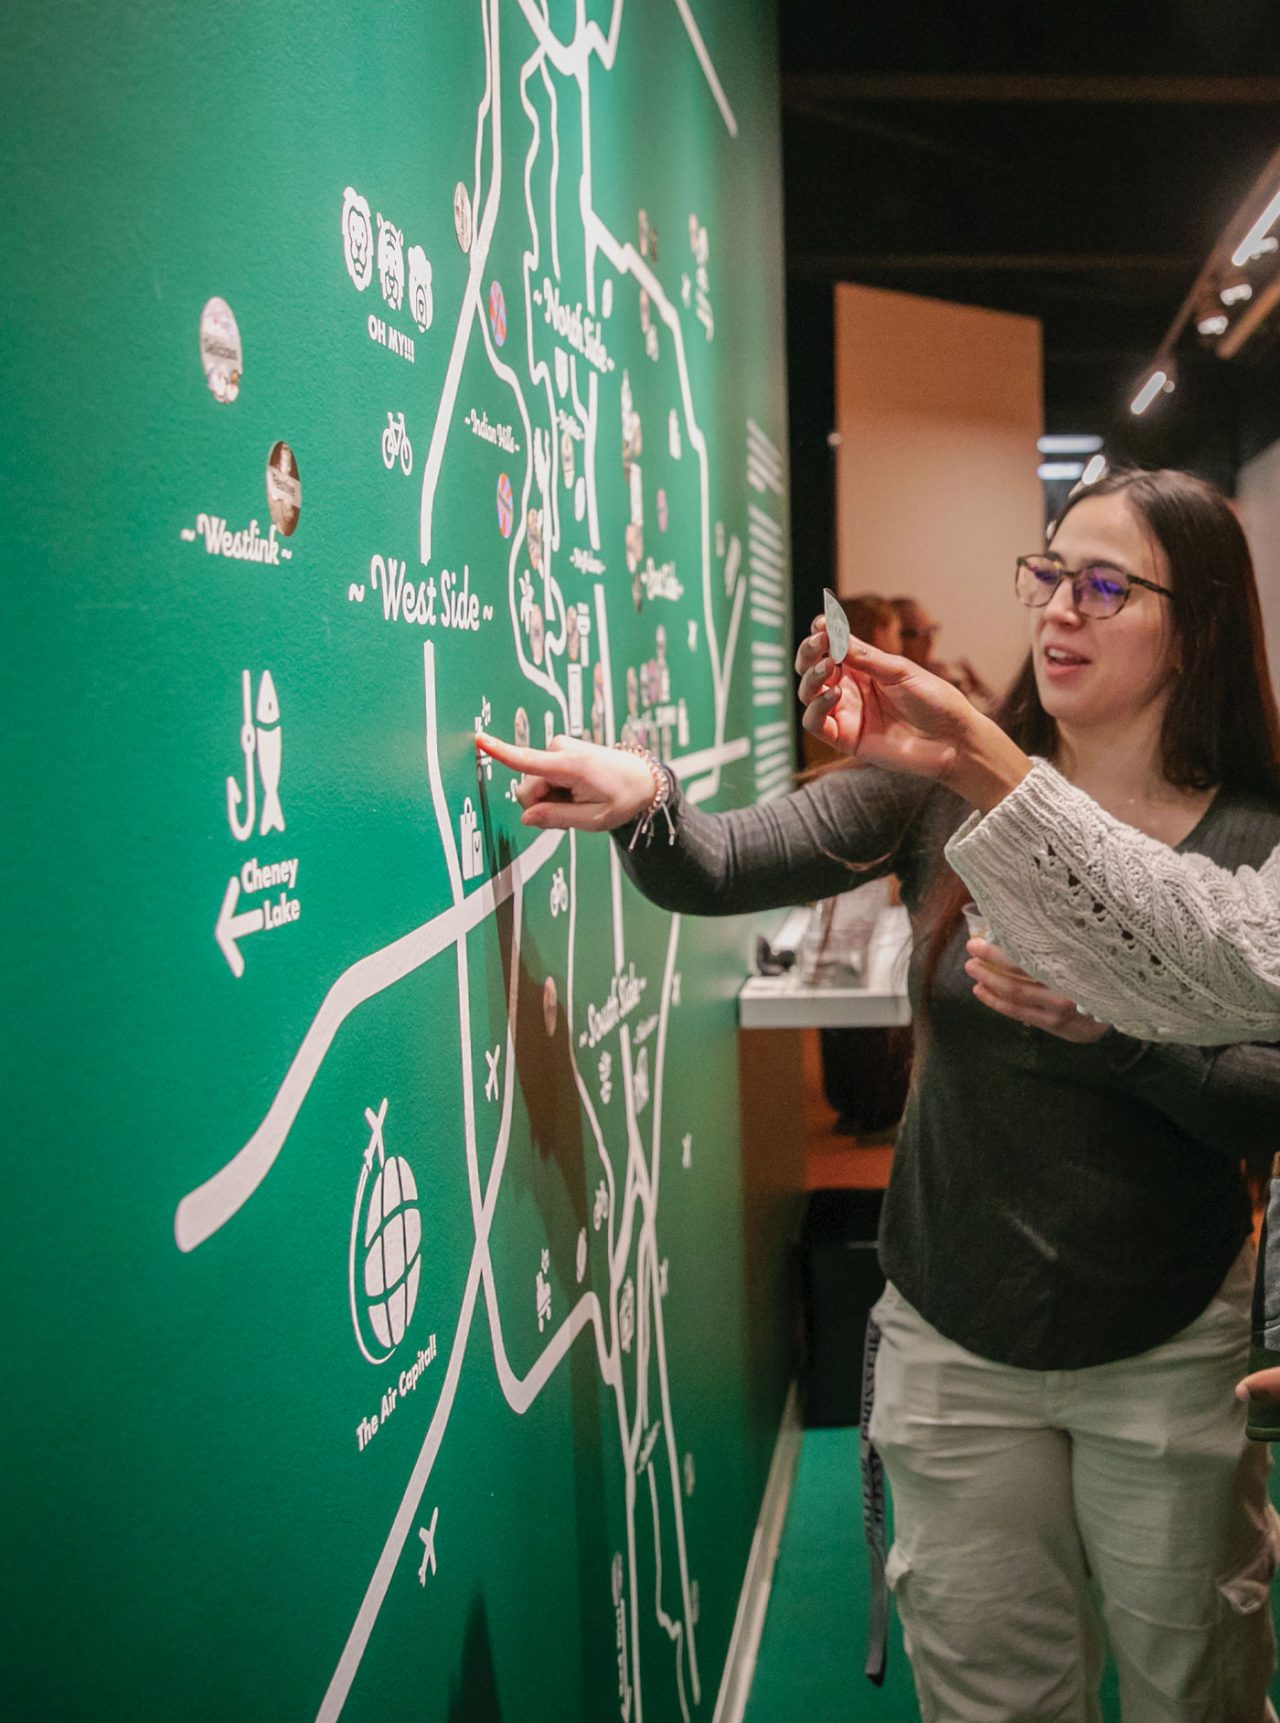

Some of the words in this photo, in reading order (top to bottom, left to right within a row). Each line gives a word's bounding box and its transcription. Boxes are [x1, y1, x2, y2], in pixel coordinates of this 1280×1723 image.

[368, 314, 386, 346] OH
[388, 326, 415, 363] MY!!!
[196, 513, 280, 565] Westlink
[370, 554, 437, 626] West
[440, 564, 480, 631] Side
[241, 857, 299, 893] Cheney
[263, 892, 301, 930] Lake
[356, 1415, 379, 1452] The
[380, 1387, 398, 1424] Air
[398, 1333, 437, 1397] Capital!
